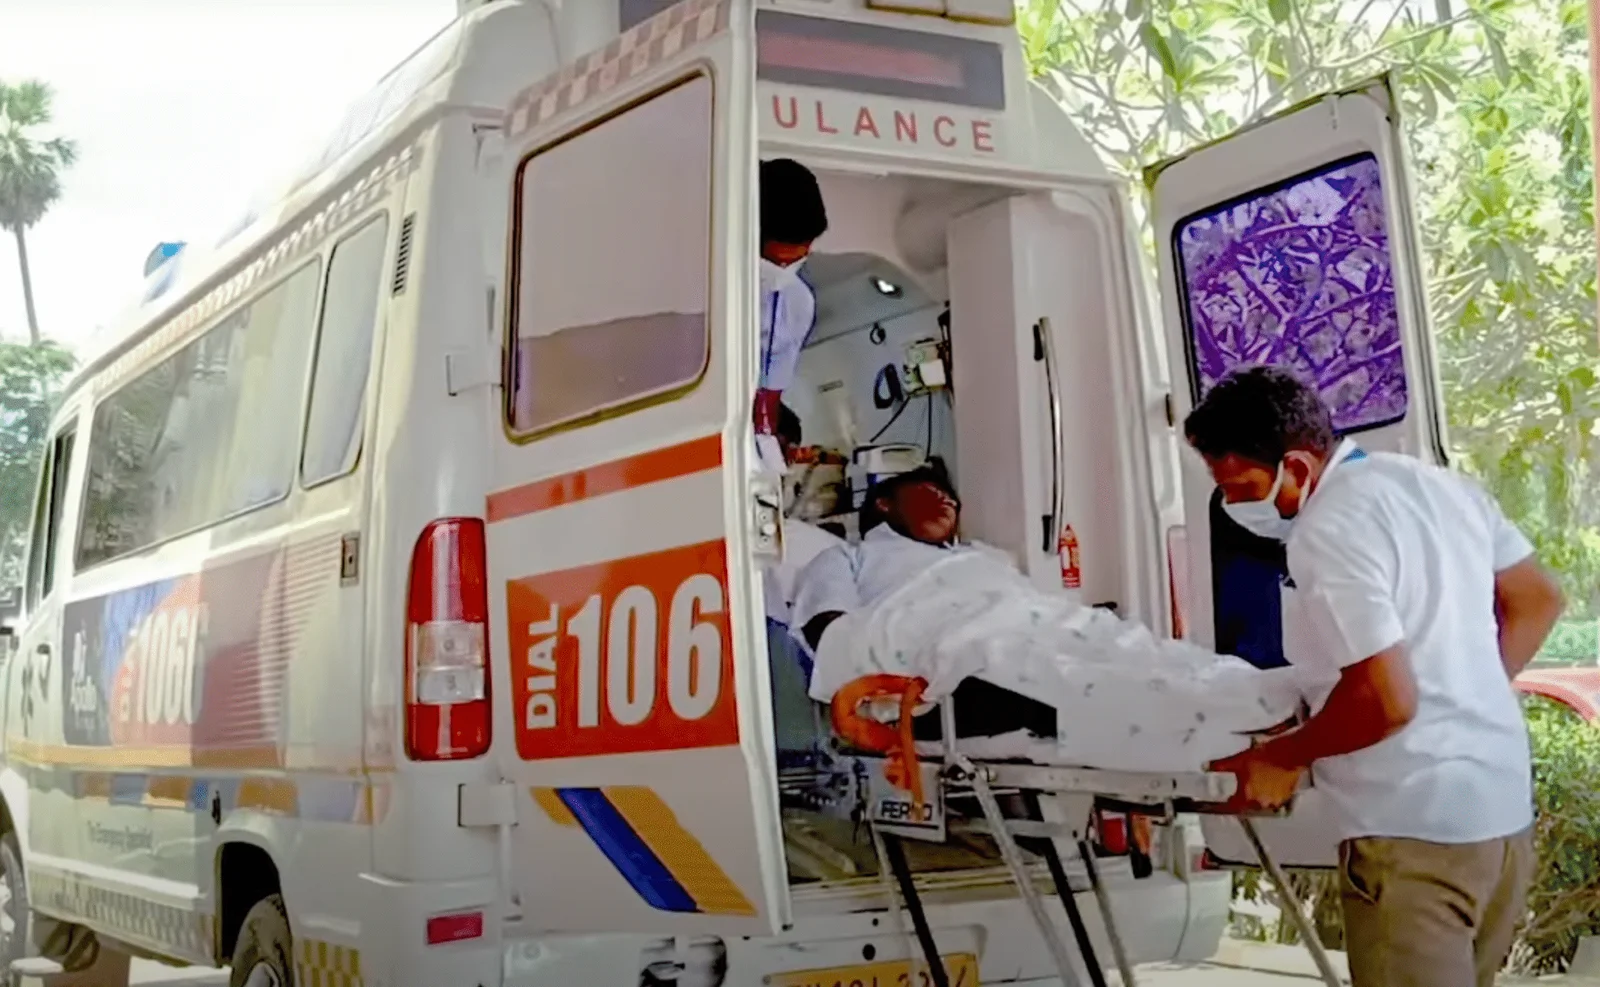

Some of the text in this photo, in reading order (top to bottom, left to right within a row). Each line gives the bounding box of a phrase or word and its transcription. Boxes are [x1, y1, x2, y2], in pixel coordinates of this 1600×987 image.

[772, 95, 995, 152] ULANCE
[526, 573, 724, 730] DIAL 106
[881, 801, 933, 821] FERO
